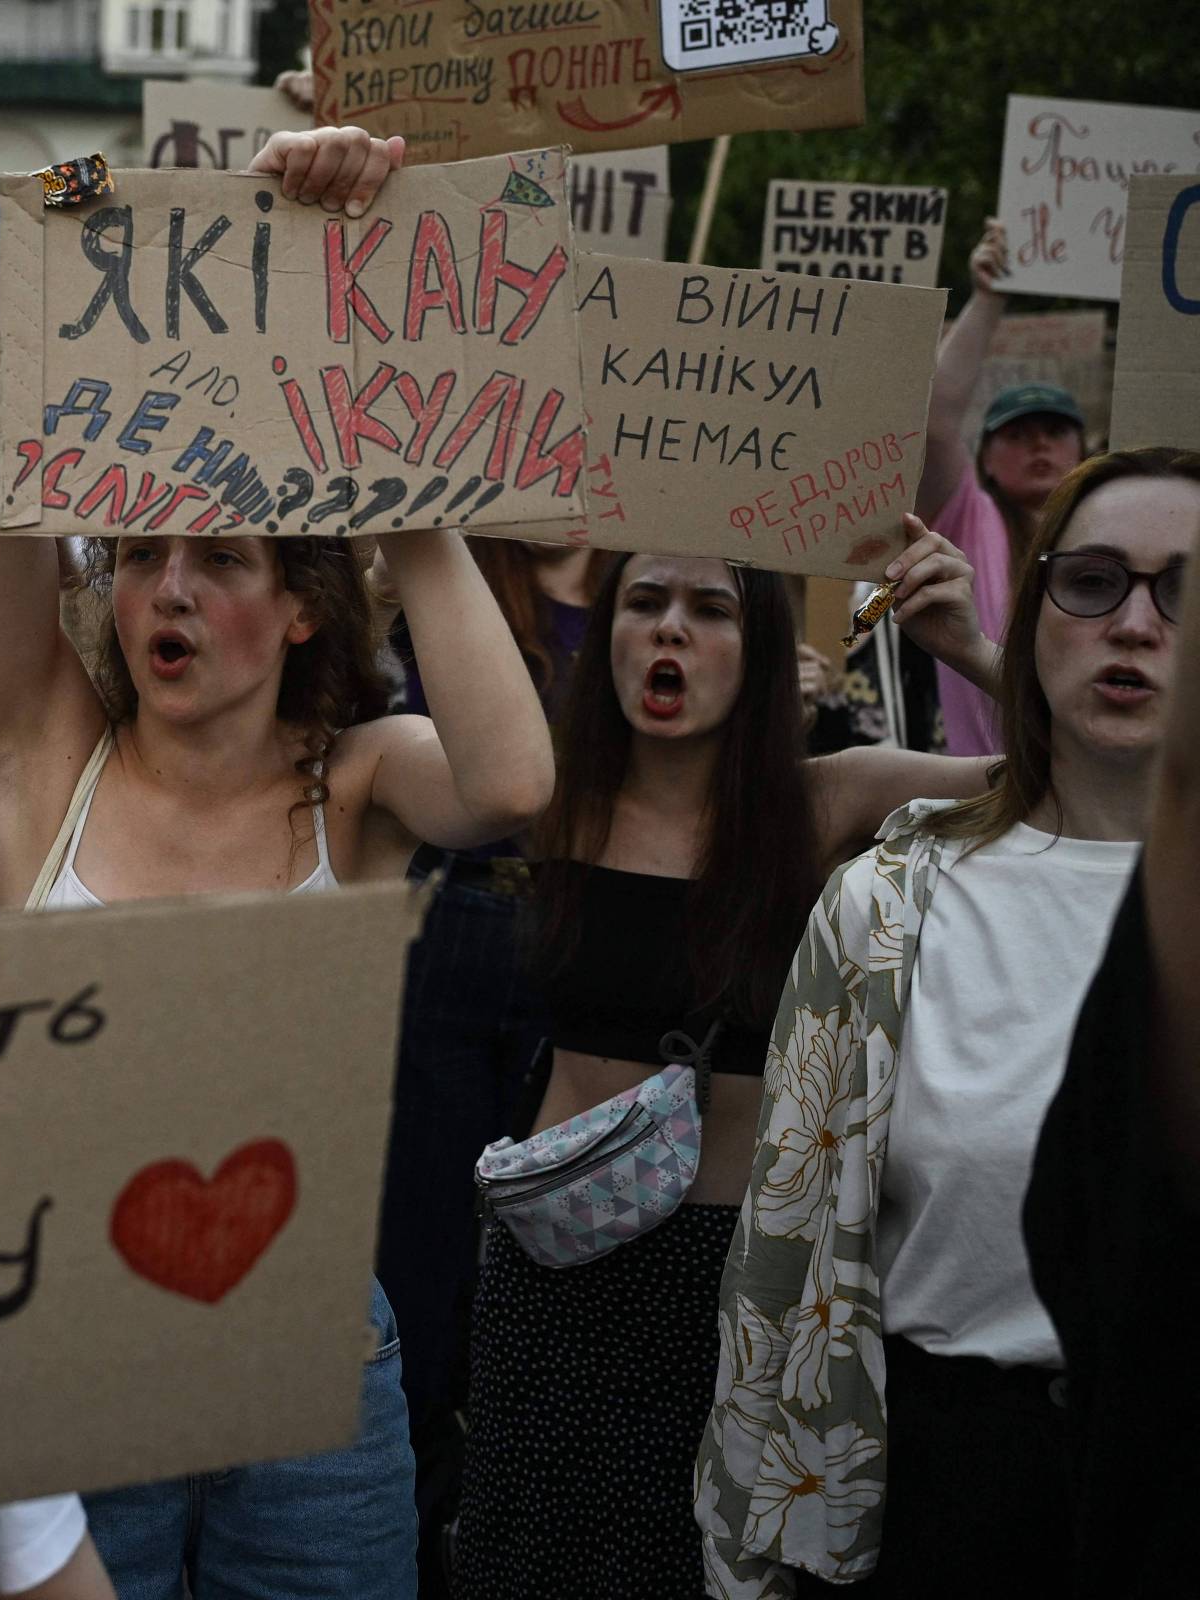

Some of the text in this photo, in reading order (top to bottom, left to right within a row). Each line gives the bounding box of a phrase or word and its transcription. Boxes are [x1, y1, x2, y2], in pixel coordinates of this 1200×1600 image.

[776, 187, 944, 226] ЦЕ ЯКИЙ
[58, 191, 275, 344] ЯКІ
[774, 225, 929, 260] ПУНКТ В
[677, 273, 852, 336] ВІЙНІ
[601, 344, 823, 409] КАНІКУЛ
[43, 378, 182, 456] ДЕ
[614, 413, 798, 471] НЕМАЄ
[781, 473, 906, 556] ПРАЙМ
